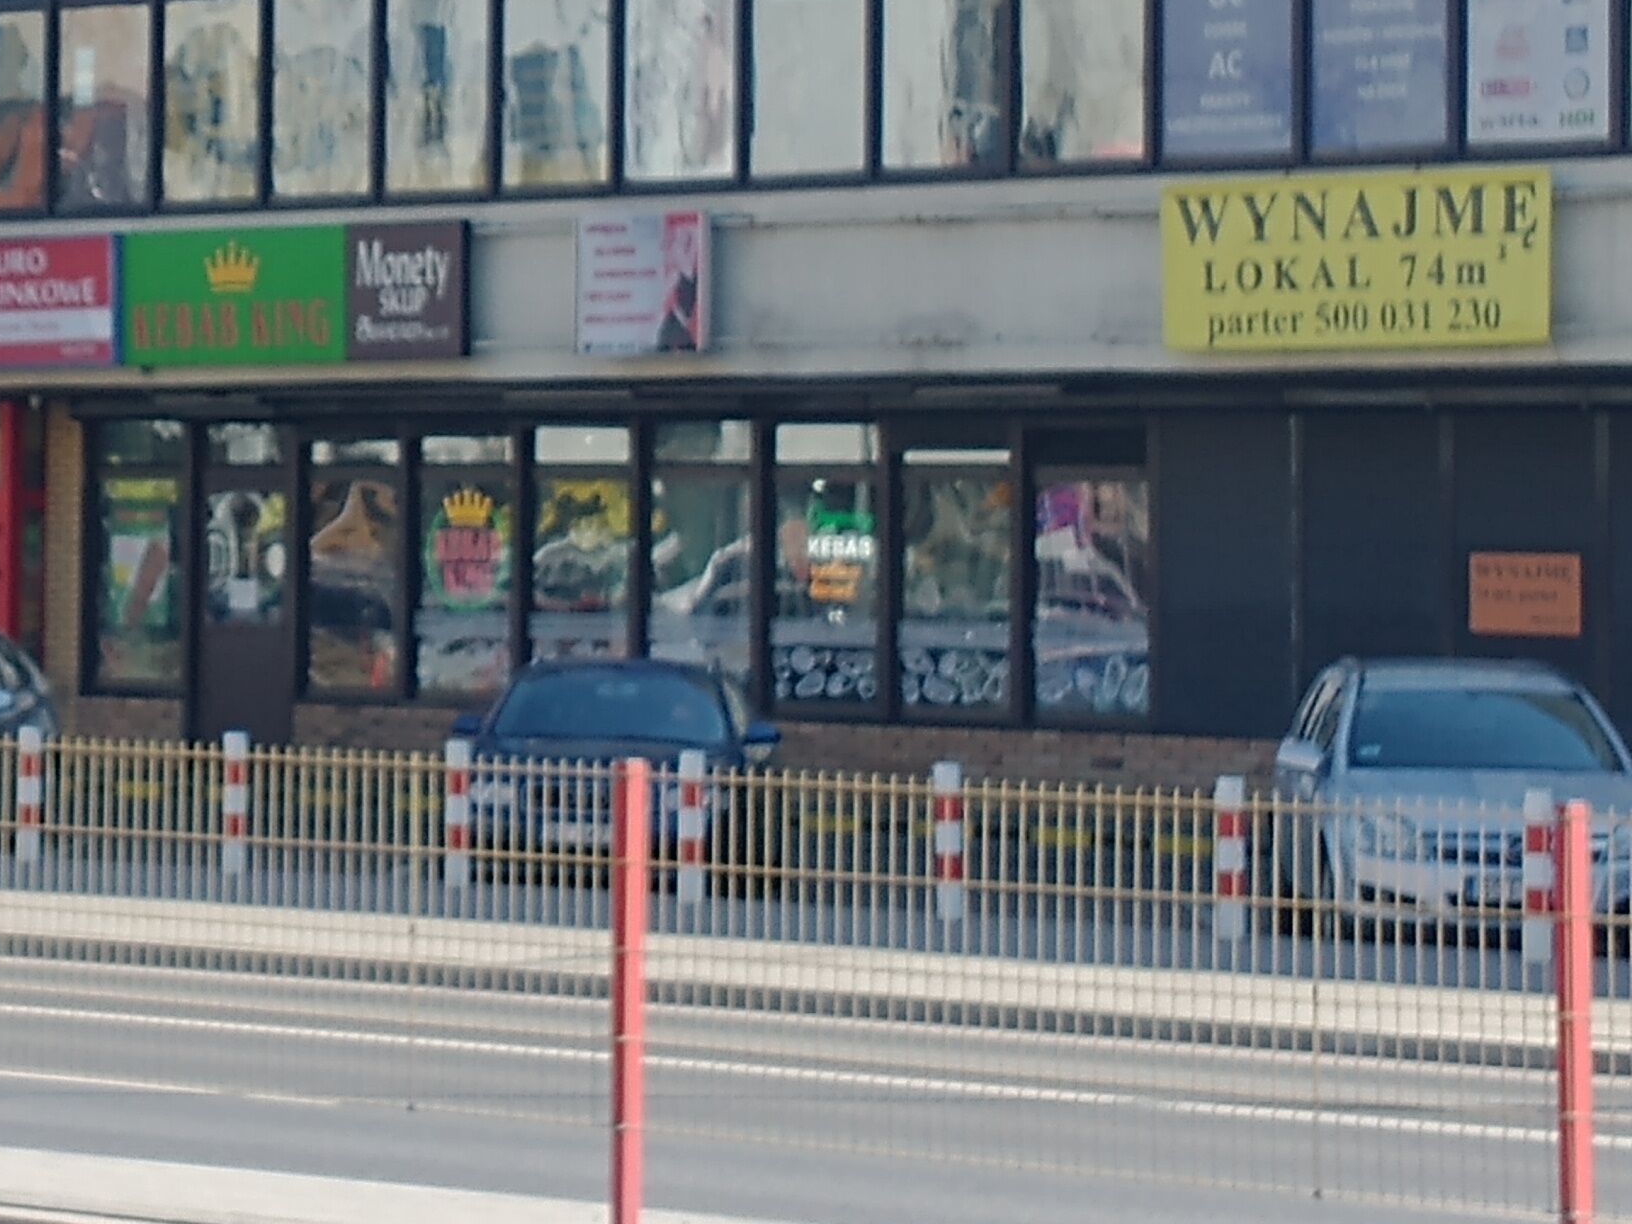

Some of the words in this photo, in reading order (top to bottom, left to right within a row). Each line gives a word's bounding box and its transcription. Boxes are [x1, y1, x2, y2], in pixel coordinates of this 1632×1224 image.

[1208, 49, 1244, 80] AC
[1175, 179, 1538, 250] WYNAJMĘ
[354, 237, 450, 300] Monety
[1203, 254, 1371, 293] LOKAL
[131, 301, 241, 351] KEBAB
[250, 297, 331, 348] KING
[1208, 304, 1304, 345] parter
[1314, 301, 1369, 334] 500
[1380, 299, 1432, 332] 031
[1448, 297, 1501, 331] 230
[806, 535, 874, 558] KEBAB
